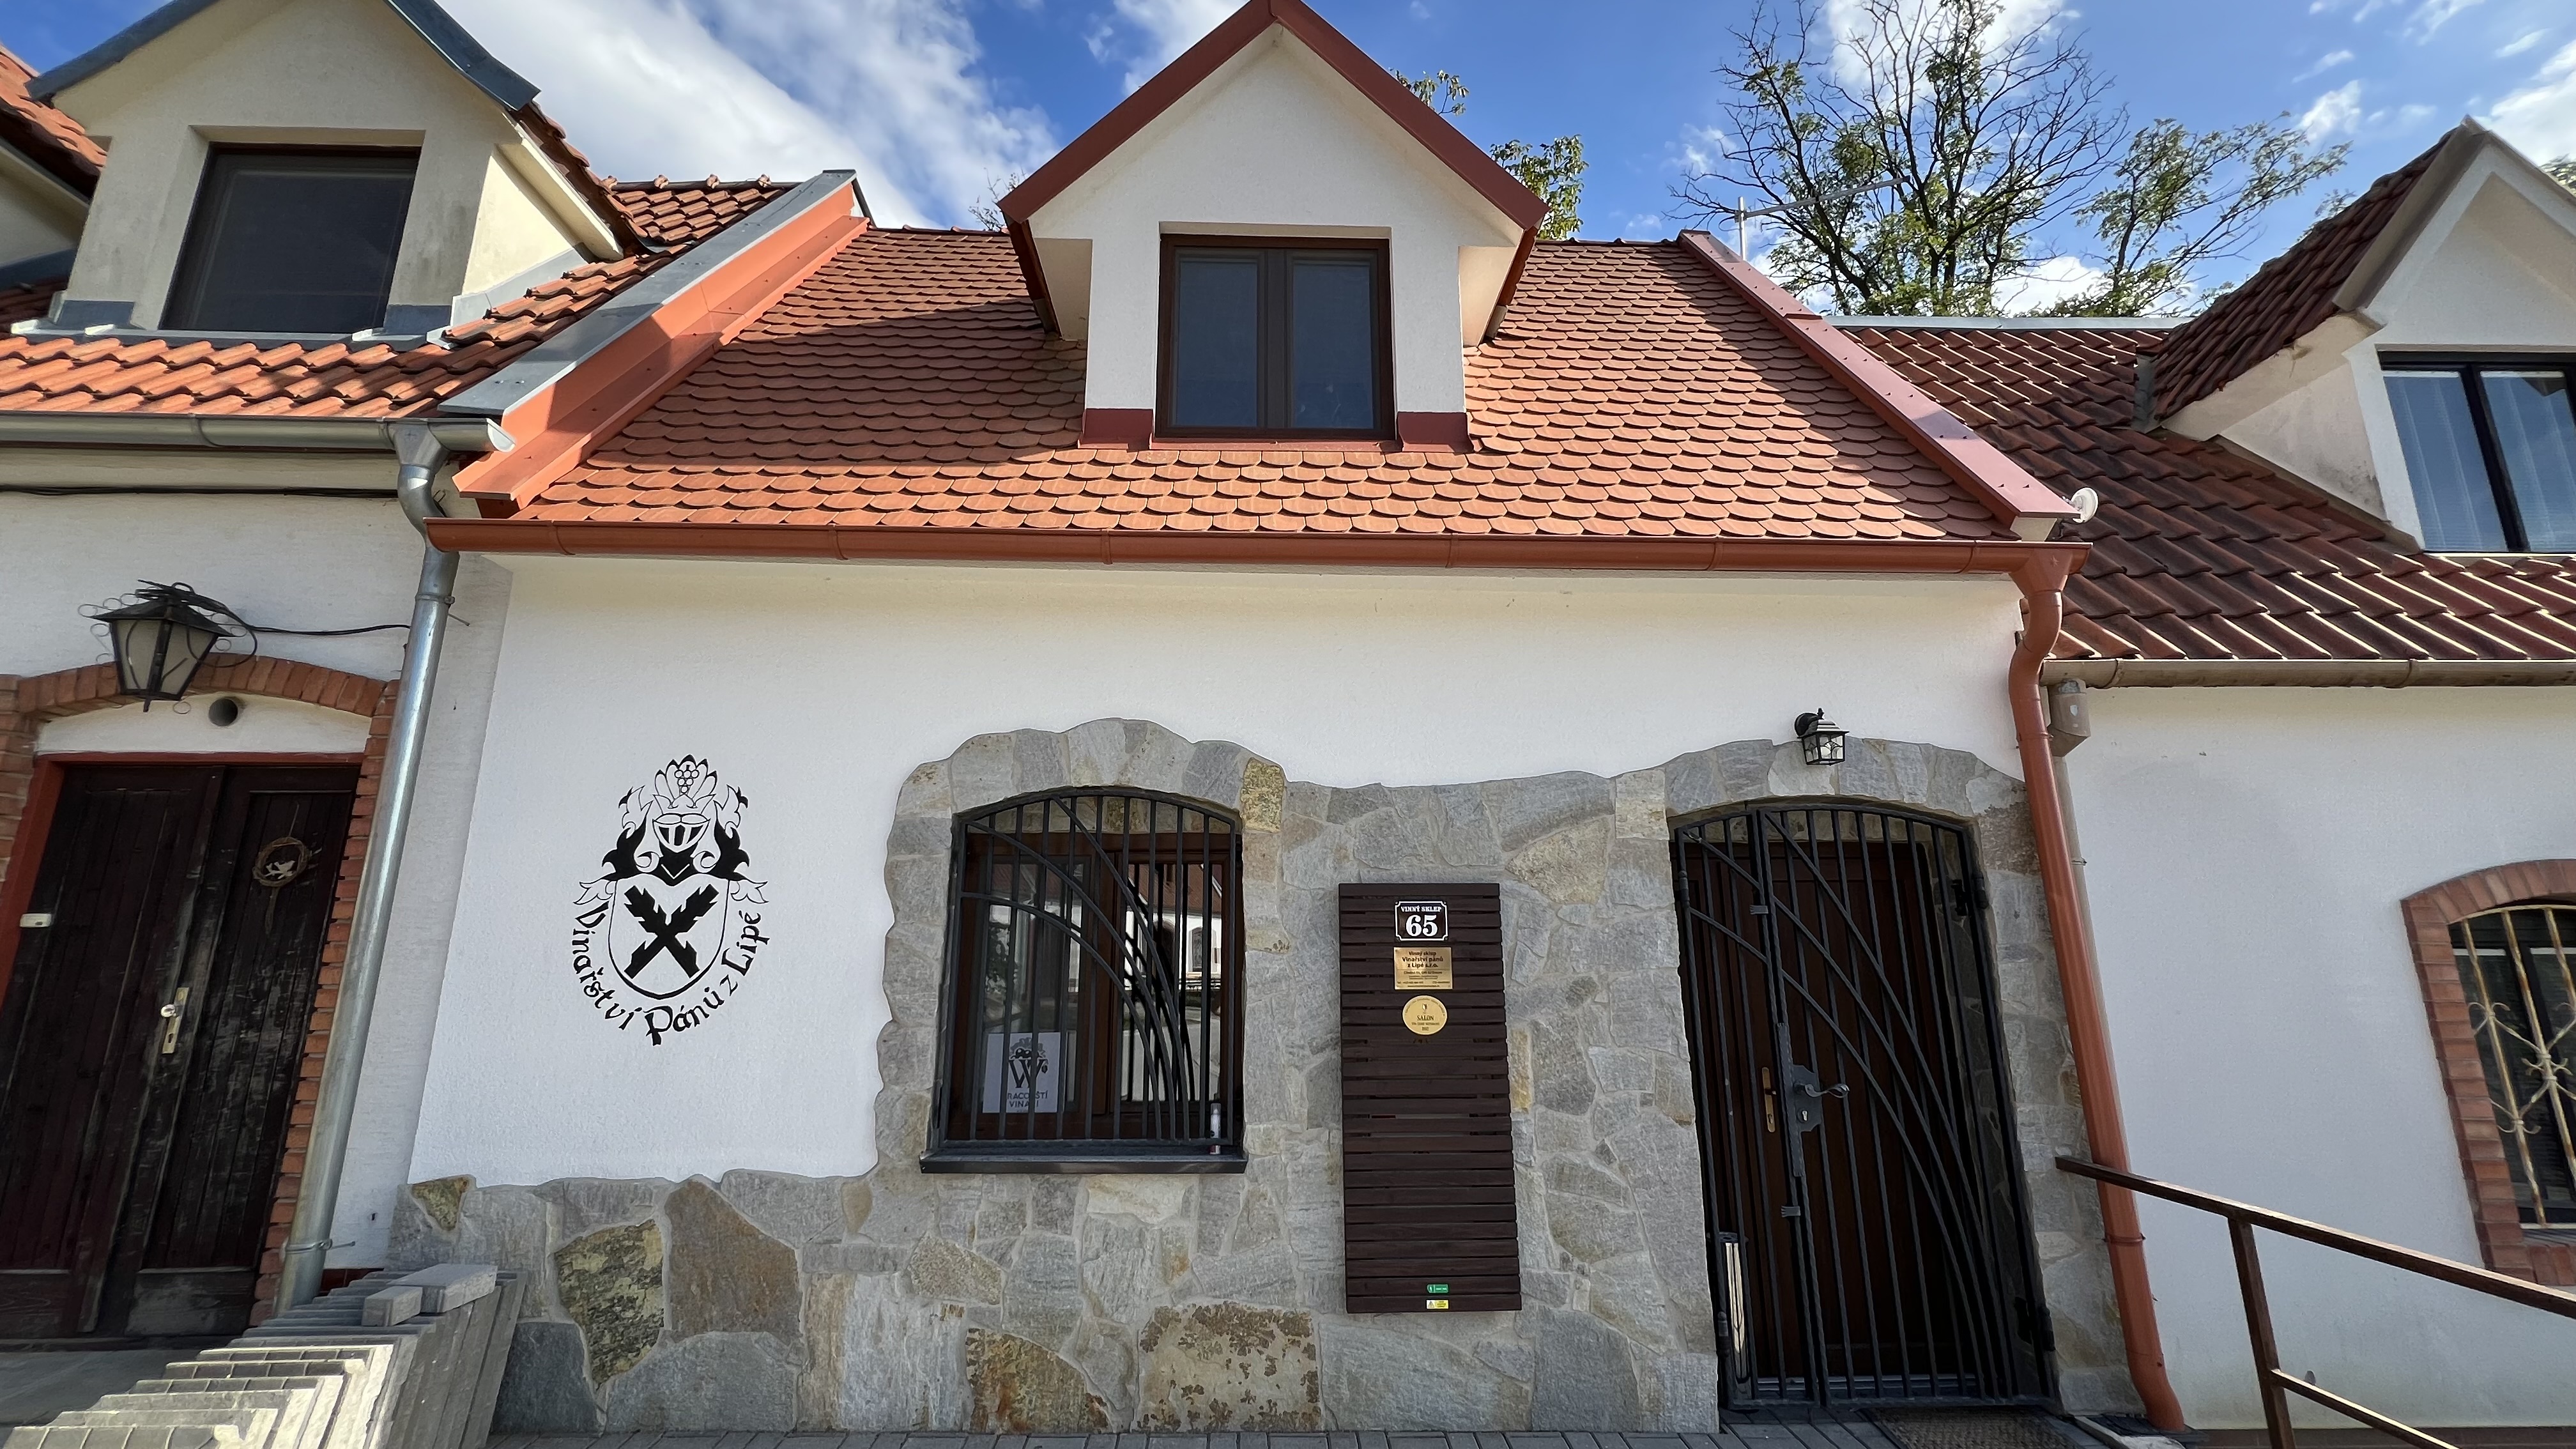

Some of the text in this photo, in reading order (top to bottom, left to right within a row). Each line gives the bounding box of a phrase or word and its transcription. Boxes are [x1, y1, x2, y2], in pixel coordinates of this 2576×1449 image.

[1406, 915, 1438, 937] 65
[721, 910, 770, 976] Lipé
[719, 974, 738, 996] z
